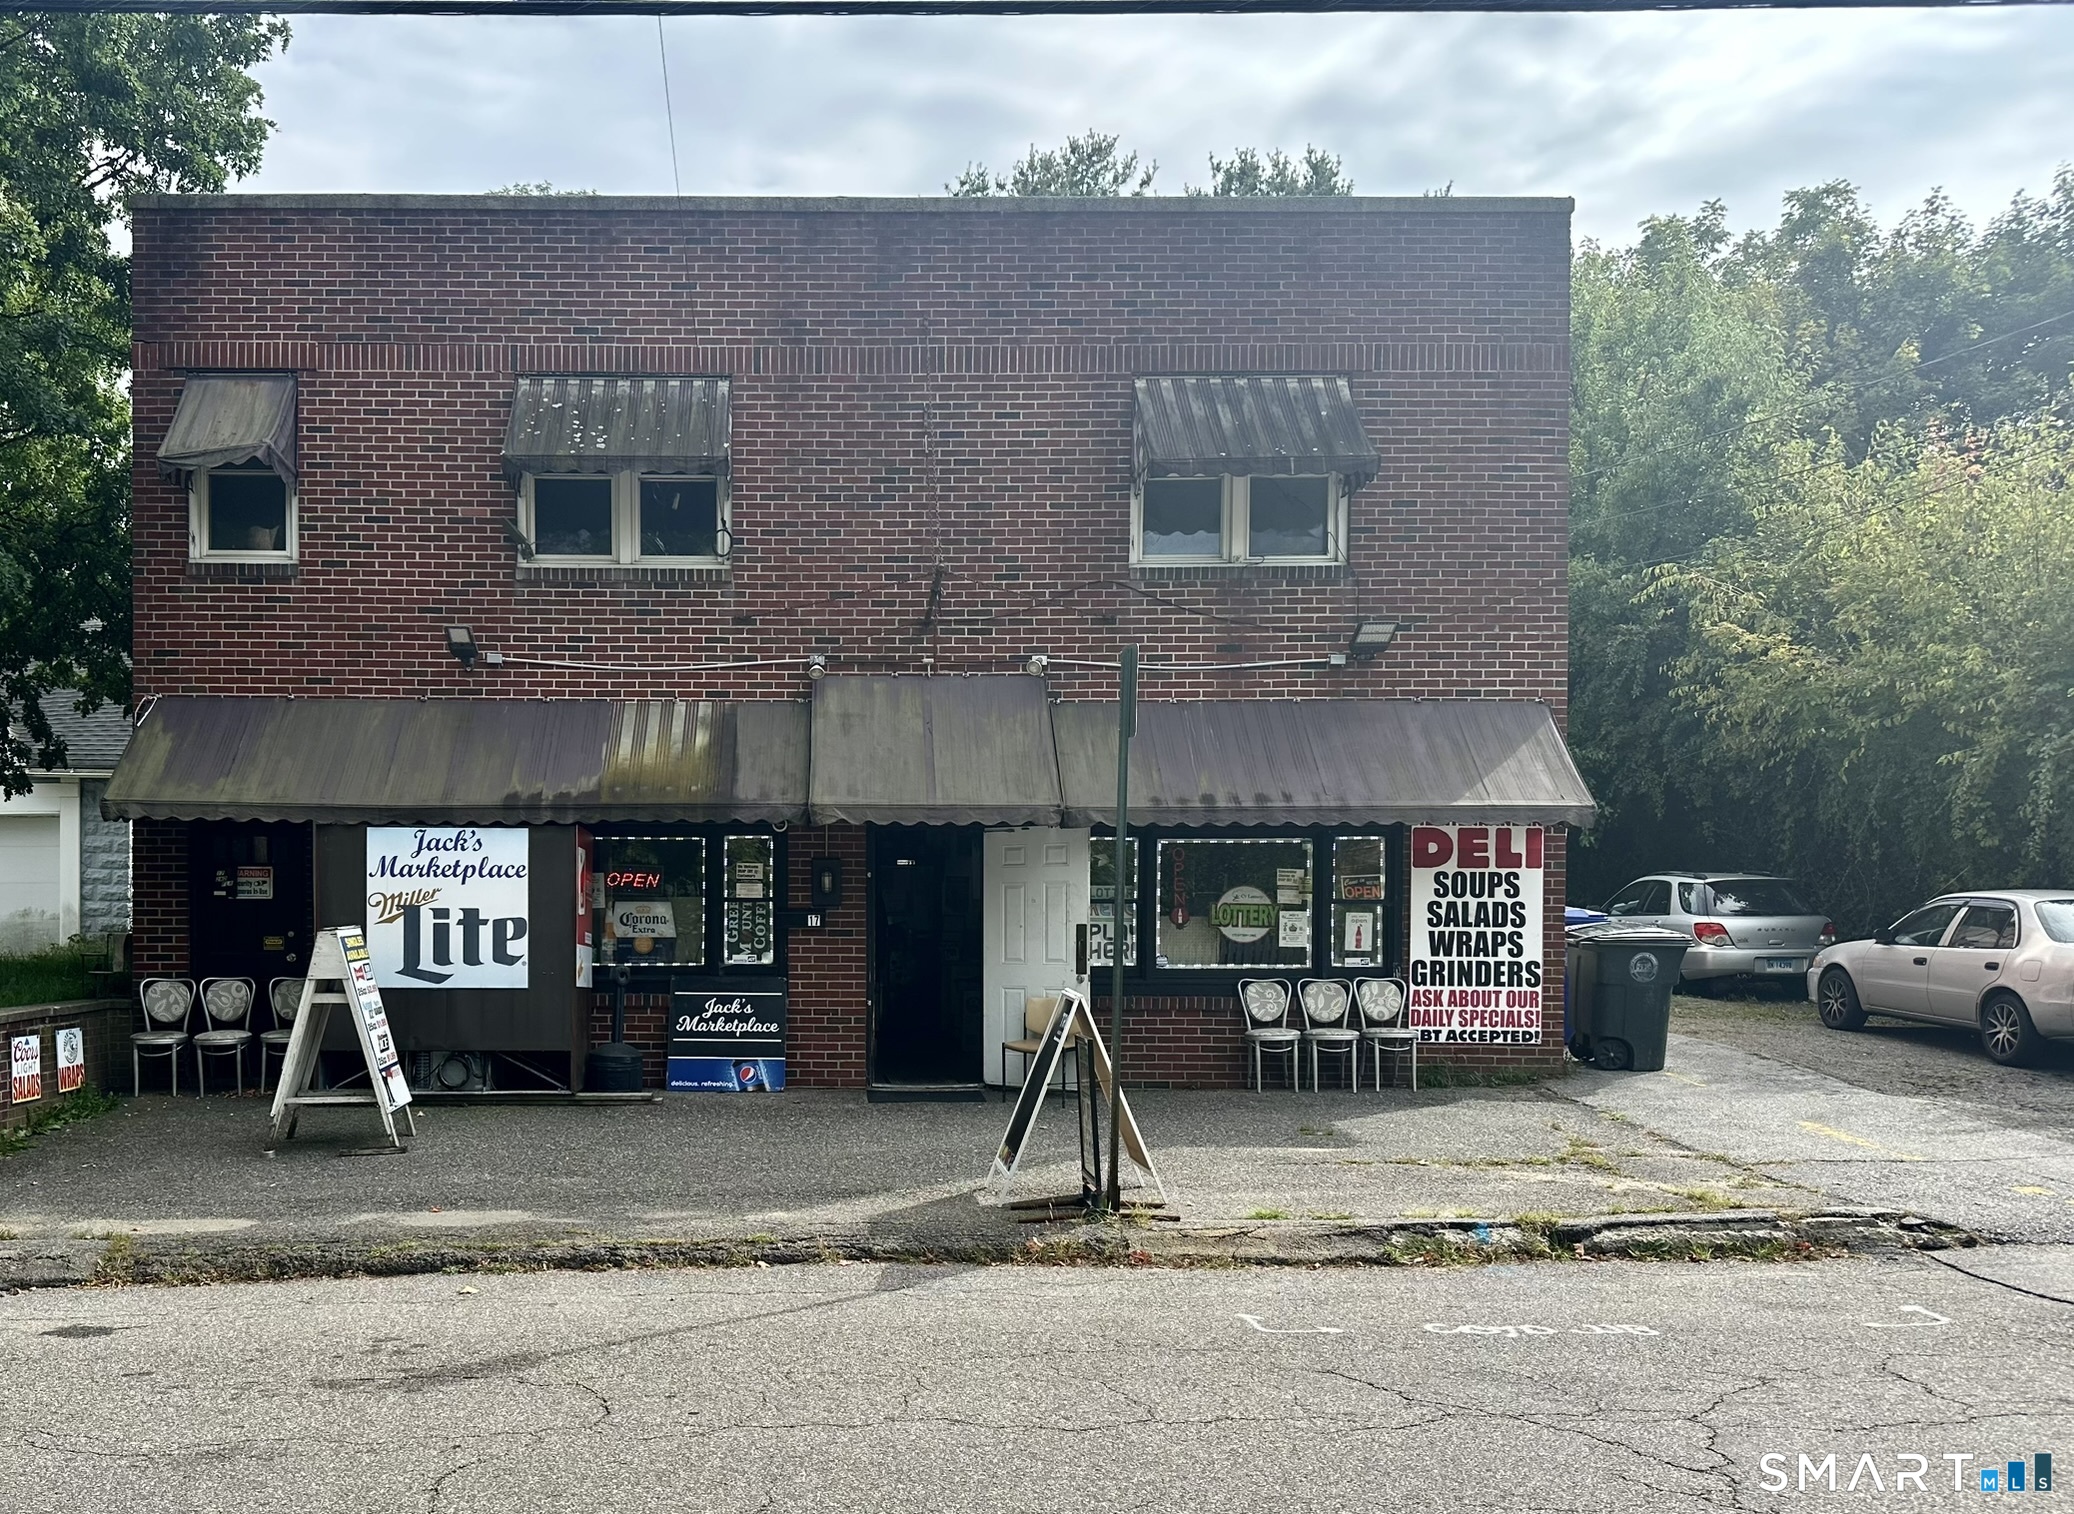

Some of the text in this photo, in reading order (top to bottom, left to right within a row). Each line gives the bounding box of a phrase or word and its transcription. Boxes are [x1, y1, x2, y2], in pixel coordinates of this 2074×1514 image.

[410, 829, 483, 858] Jack's
[1412, 827, 1543, 869] DELI
[368, 855, 528, 885] Marketplace
[607, 872, 660, 888] OPEN
[1172, 847, 1186, 906] OPEN
[1345, 885, 1380, 898] OPEN
[1433, 871, 1520, 899] SOUPS
[368, 888, 443, 920] Miller
[1211, 903, 1279, 927] LOTTERY
[1427, 901, 1526, 928] SALADS
[619, 912, 668, 928] Corona
[632, 925, 656, 934] Extra
[809, 915, 819, 926] 17
[394, 905, 528, 985] Lite
[1090, 941, 1134, 959] HER
[1428, 930, 1524, 958] WRAPS
[1411, 960, 1541, 988] GRINDERS
[701, 998, 754, 1018] Jack's
[1411, 989, 1540, 1009] ASK ABOUT OUR
[676, 1015, 780, 1037] Marketplace
[1410, 1009, 1541, 1029] DAILY SPECIALS!
[1446, 1029, 1541, 1043] ACCEPTED!
[13, 1041, 39, 1063] Coors
[16, 1061, 37, 1075] LIGHT
[58, 1063, 85, 1090] WRAPS
[12, 1072, 40, 1101] SALADS
[701, 1080, 734, 1088] refreshing.
